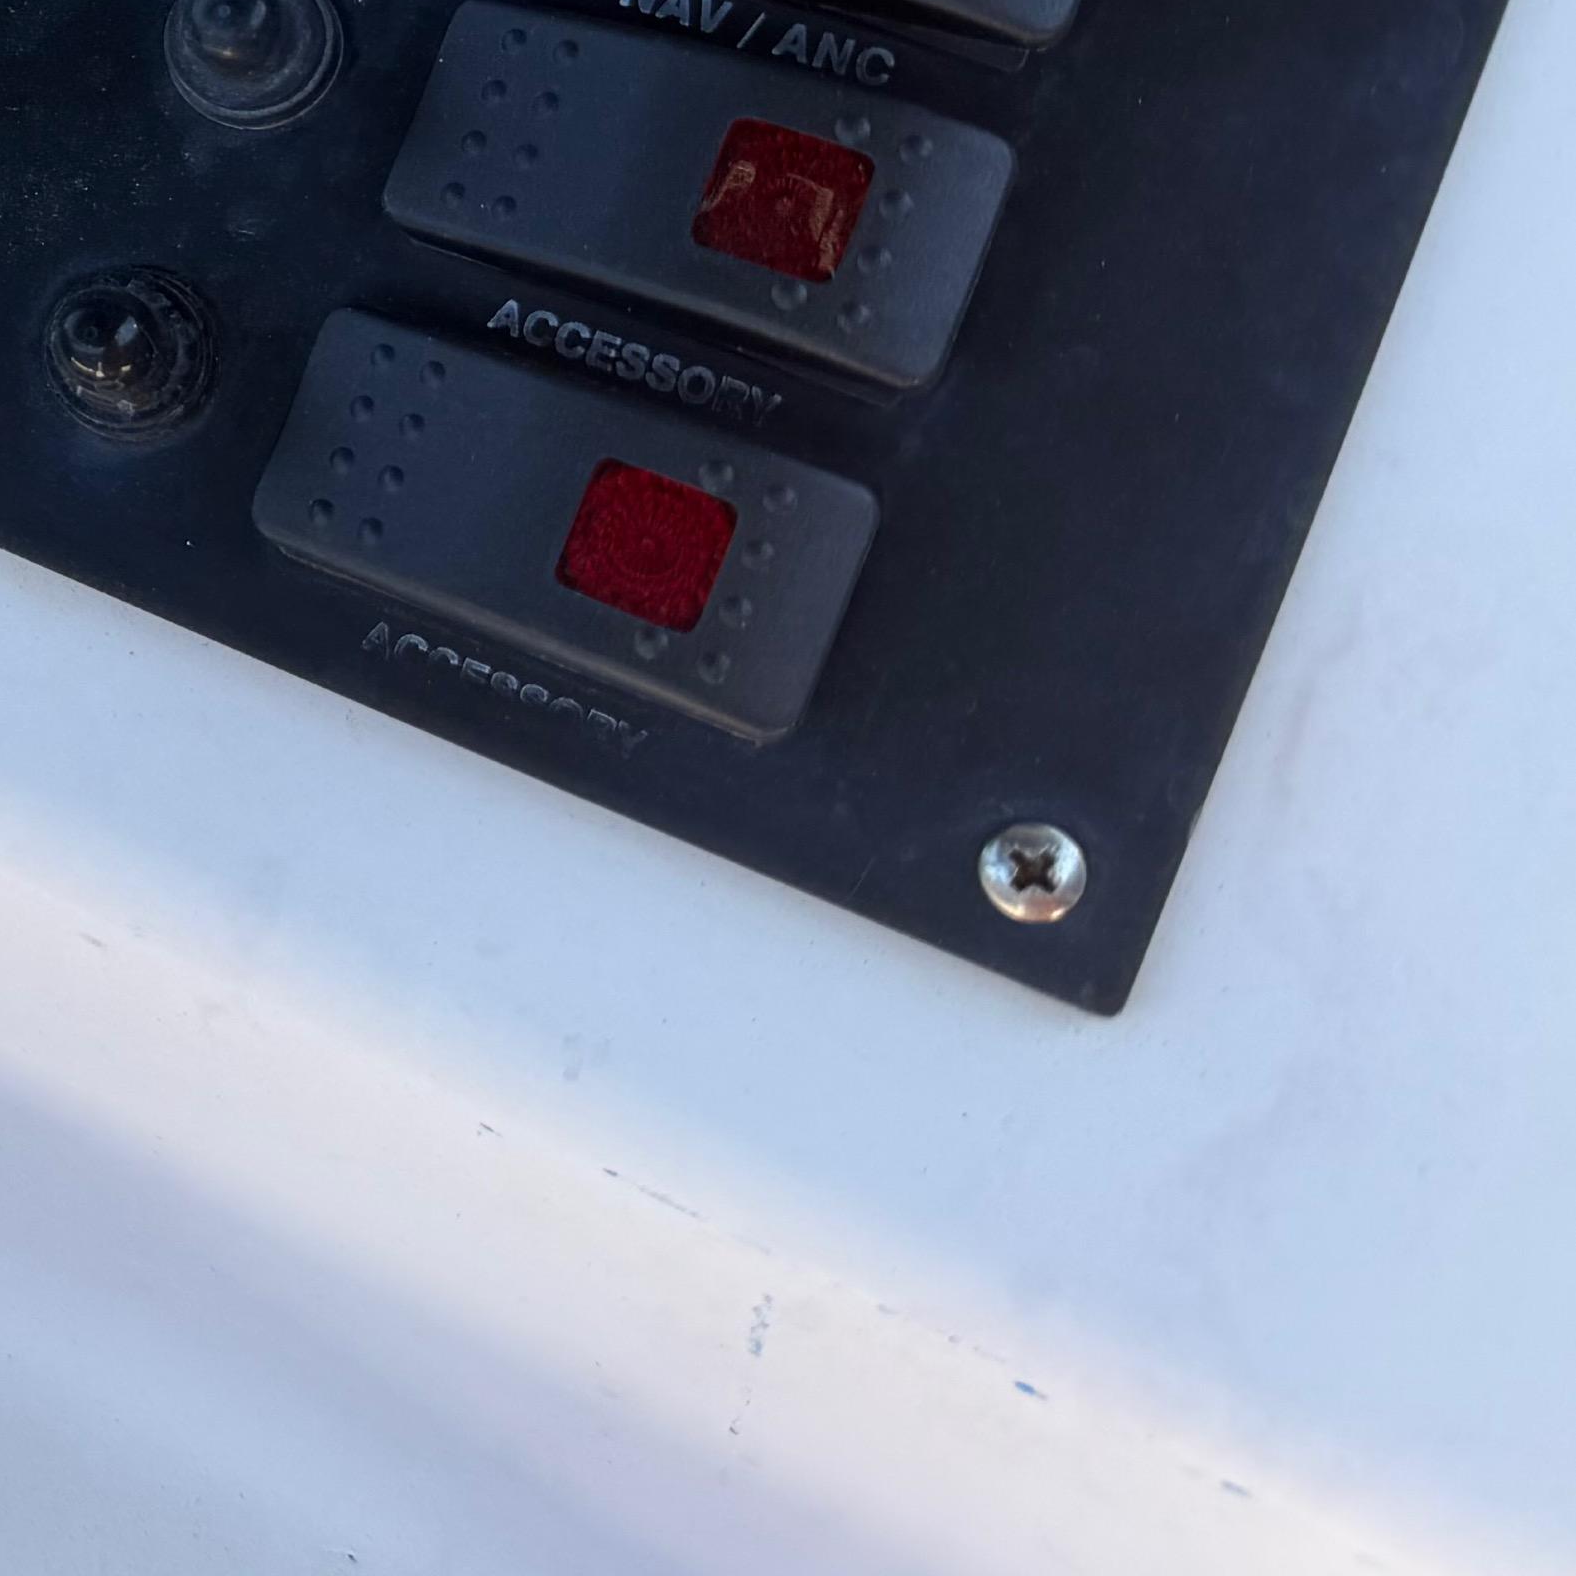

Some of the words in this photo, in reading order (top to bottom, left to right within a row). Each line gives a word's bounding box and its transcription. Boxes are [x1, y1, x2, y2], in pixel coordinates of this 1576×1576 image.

[736, 11, 766, 49] /
[771, 22, 896, 86] ANC
[486, 297, 783, 425] ACCESSORY
